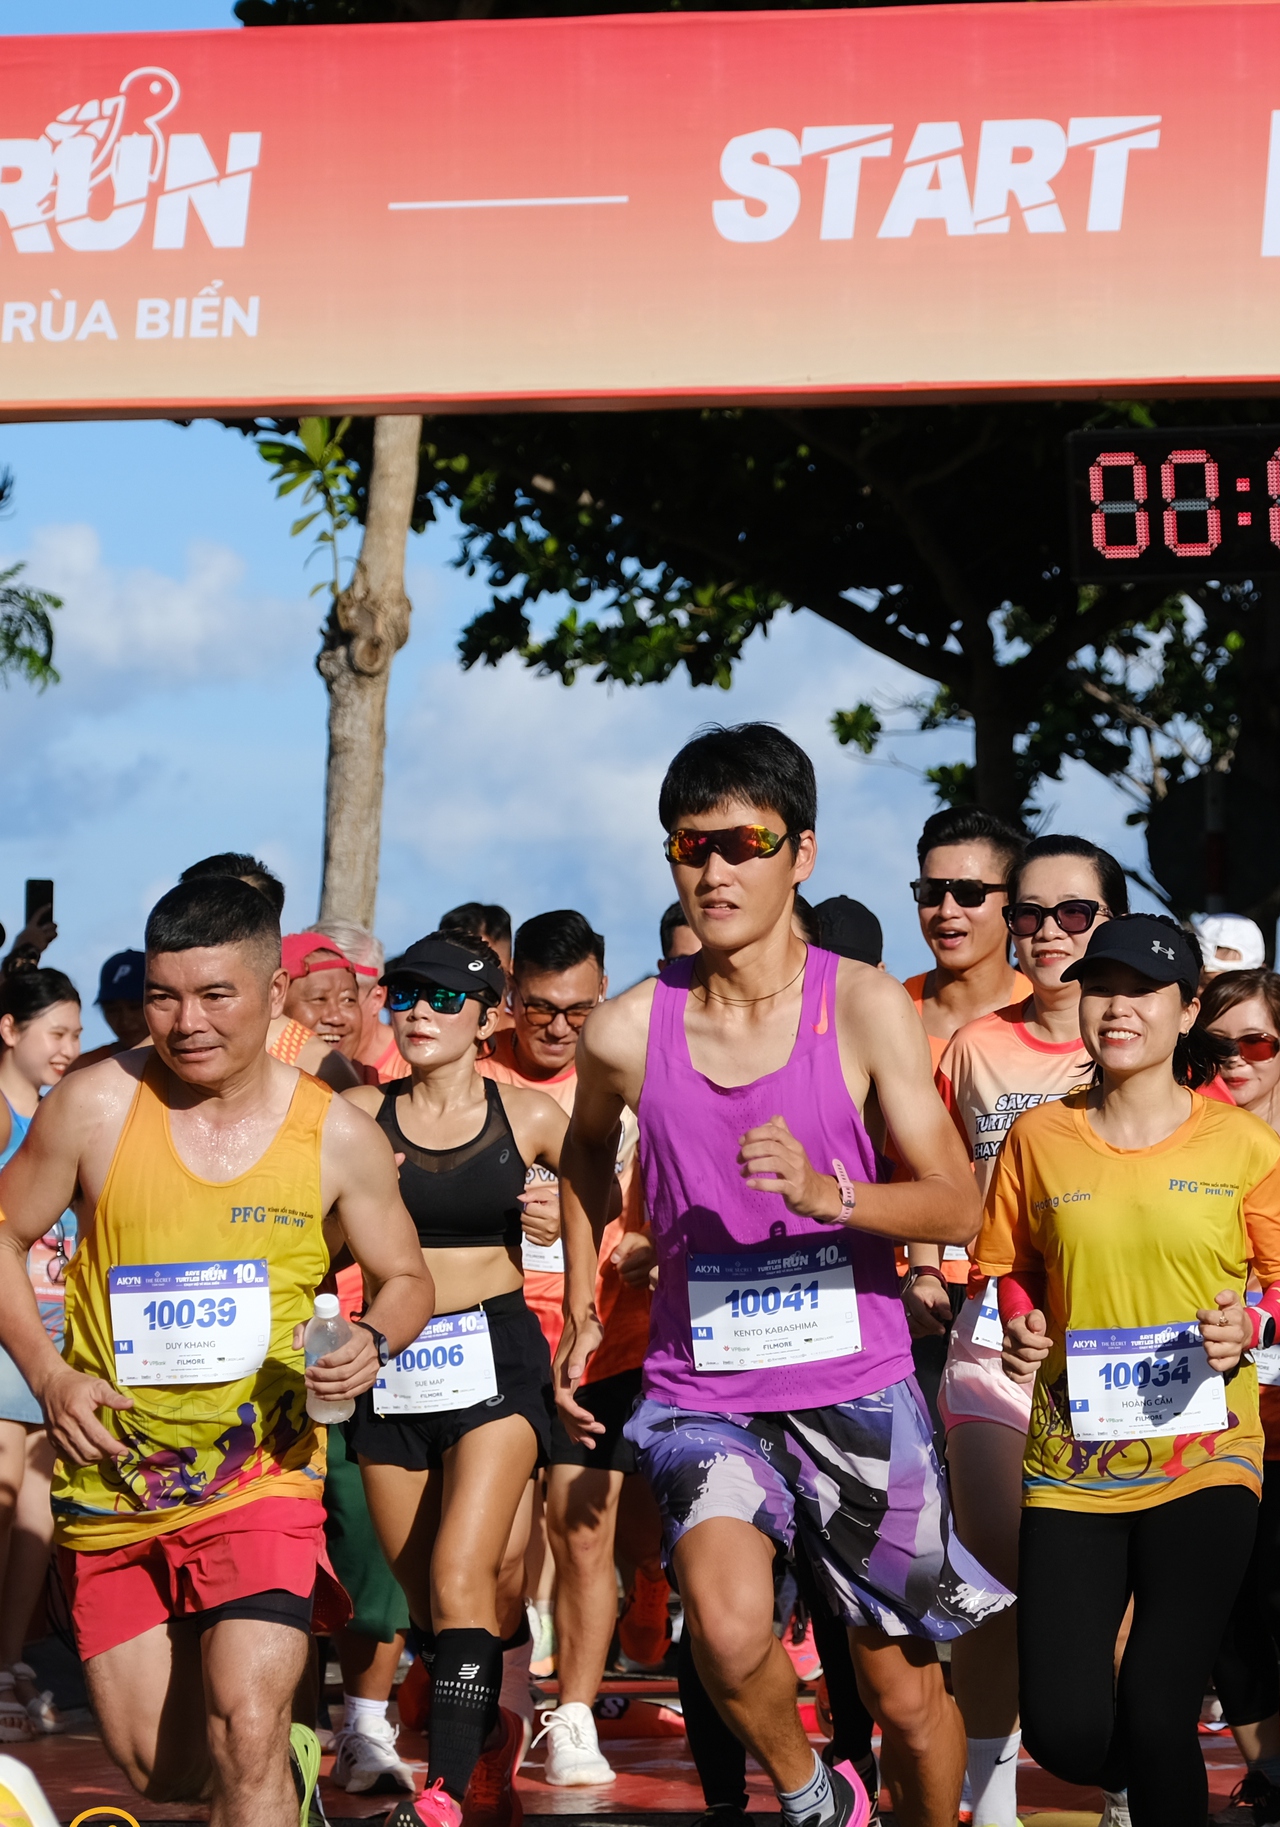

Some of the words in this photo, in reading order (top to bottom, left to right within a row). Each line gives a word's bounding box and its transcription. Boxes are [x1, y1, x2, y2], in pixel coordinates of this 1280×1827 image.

[712, 115, 1162, 243] START
[1, 289, 118, 342] RÙA
[135, 279, 261, 339] BIỂN
[995, 1092, 1042, 1111] SAVE
[1168, 1179, 1198, 1193] PFG
[230, 1206, 266, 1224] PFG
[782, 1255, 809, 1268] RUN
[816, 1245, 839, 1267] 10
[116, 1276, 141, 1286] AKYN
[233, 1263, 256, 1284] 10
[200, 1269, 227, 1282] RUN
[695, 1265, 720, 1273] AKYN
[725, 1280, 819, 1318] 10041
[143, 1297, 237, 1331] 10039
[986, 1308, 993, 1316] F
[433, 1321, 453, 1333] RUN
[458, 1315, 477, 1333] 10
[733, 1330, 763, 1338] KENTO
[765, 1321, 818, 1335] KABASHIMA
[697, 1329, 707, 1337] M
[1154, 1331, 1179, 1344] RUN
[119, 1342, 128, 1351] M
[165, 1342, 182, 1350] DUY
[183, 1341, 216, 1349] KHANG
[763, 1341, 793, 1350] FILMORE
[1072, 1340, 1097, 1348] AKYN
[1099, 1356, 1191, 1390] 10034
[429, 1378, 444, 1386] MAP
[1076, 1401, 1082, 1409] F
[1122, 1398, 1153, 1408] HOÀNG
[1135, 1414, 1162, 1422] FILMORE
